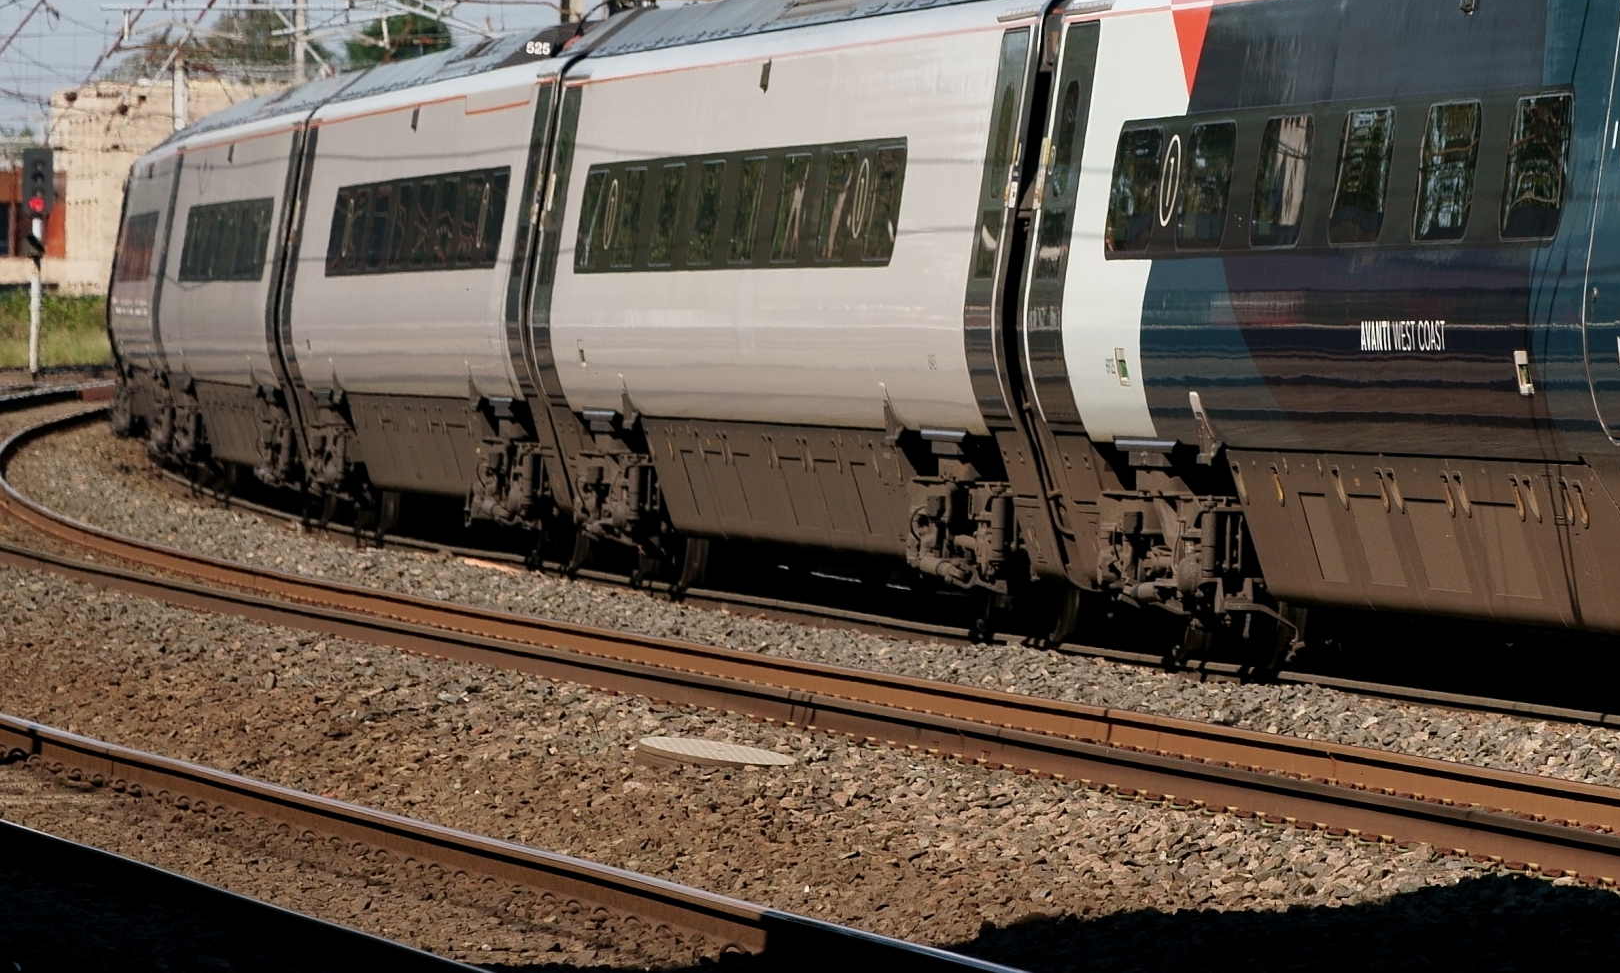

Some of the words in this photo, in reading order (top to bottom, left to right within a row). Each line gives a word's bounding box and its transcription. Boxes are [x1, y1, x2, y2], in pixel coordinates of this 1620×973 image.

[1360, 320, 1392, 351] AVANTI
[1392, 320, 1416, 352] WEST
[1417, 319, 1446, 352] COAST
